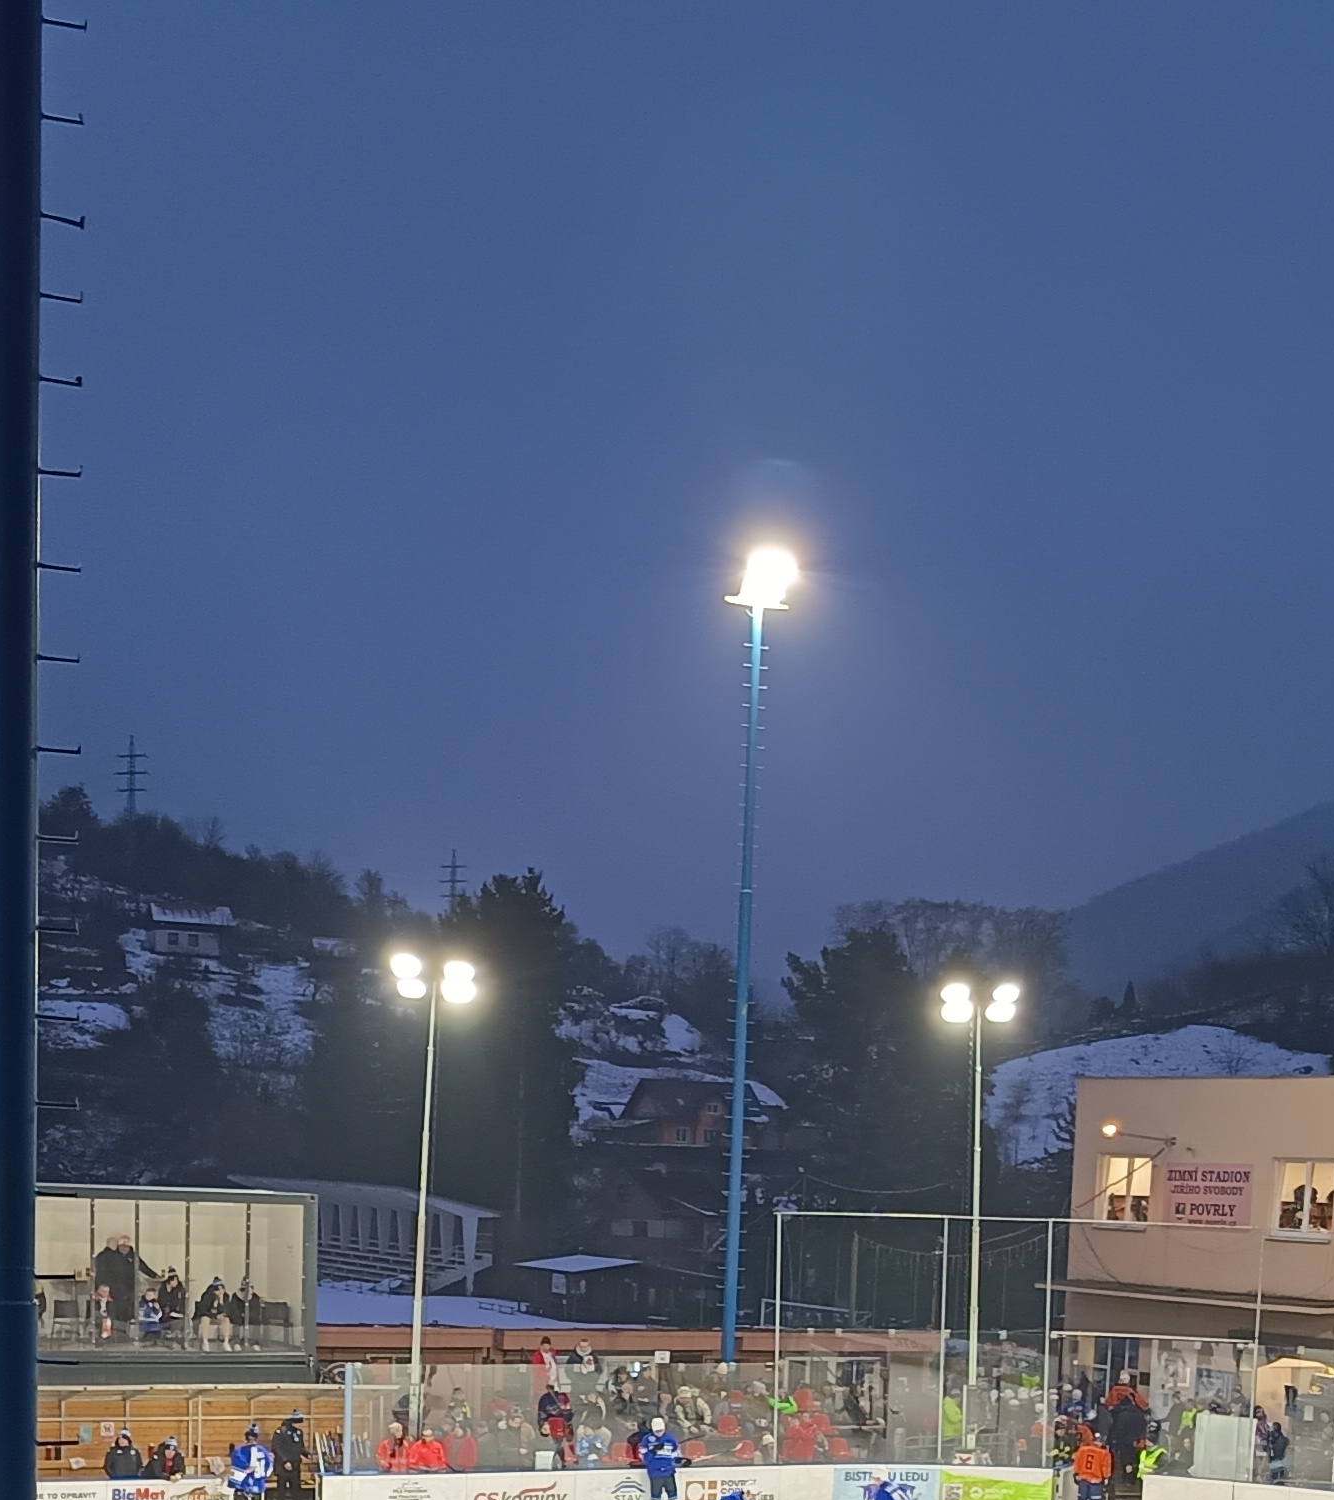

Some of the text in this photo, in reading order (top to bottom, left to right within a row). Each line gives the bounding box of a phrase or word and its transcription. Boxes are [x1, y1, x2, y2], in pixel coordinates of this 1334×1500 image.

[1167, 1167, 1251, 1183] ZIMNÍ STADION
[1203, 1185, 1245, 1196] SVOBODY
[1189, 1203, 1237, 1217] POVRLY
[1085, 1454, 1094, 1469] 6
[844, 1471, 873, 1482] BIST
[899, 1471, 930, 1482] LEDU
